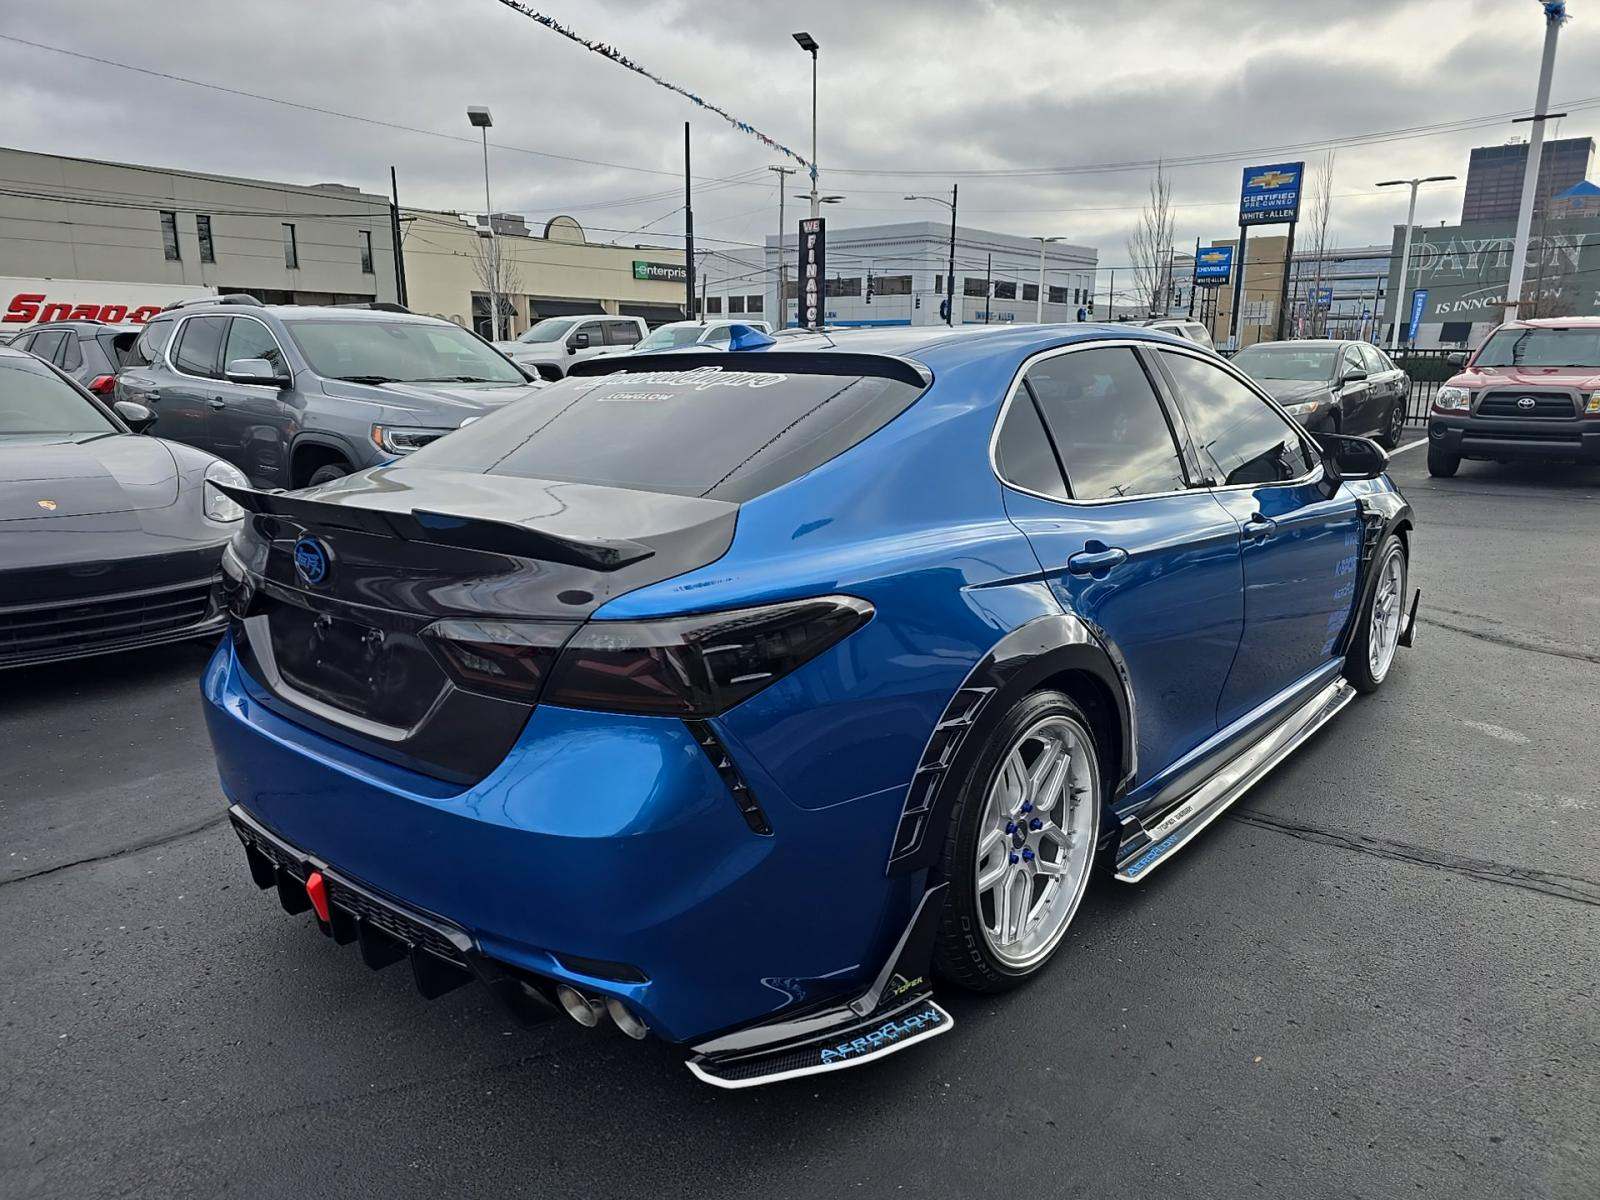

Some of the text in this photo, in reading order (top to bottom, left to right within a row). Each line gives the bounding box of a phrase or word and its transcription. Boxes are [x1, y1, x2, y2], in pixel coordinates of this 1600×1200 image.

[1243, 192, 1296, 203] CERTIFIED
[1244, 199, 1293, 208] PRE-OWNED
[803, 220, 820, 233] WE
[635, 265, 687, 279] enterpris
[1434, 303, 1450, 315] IS
